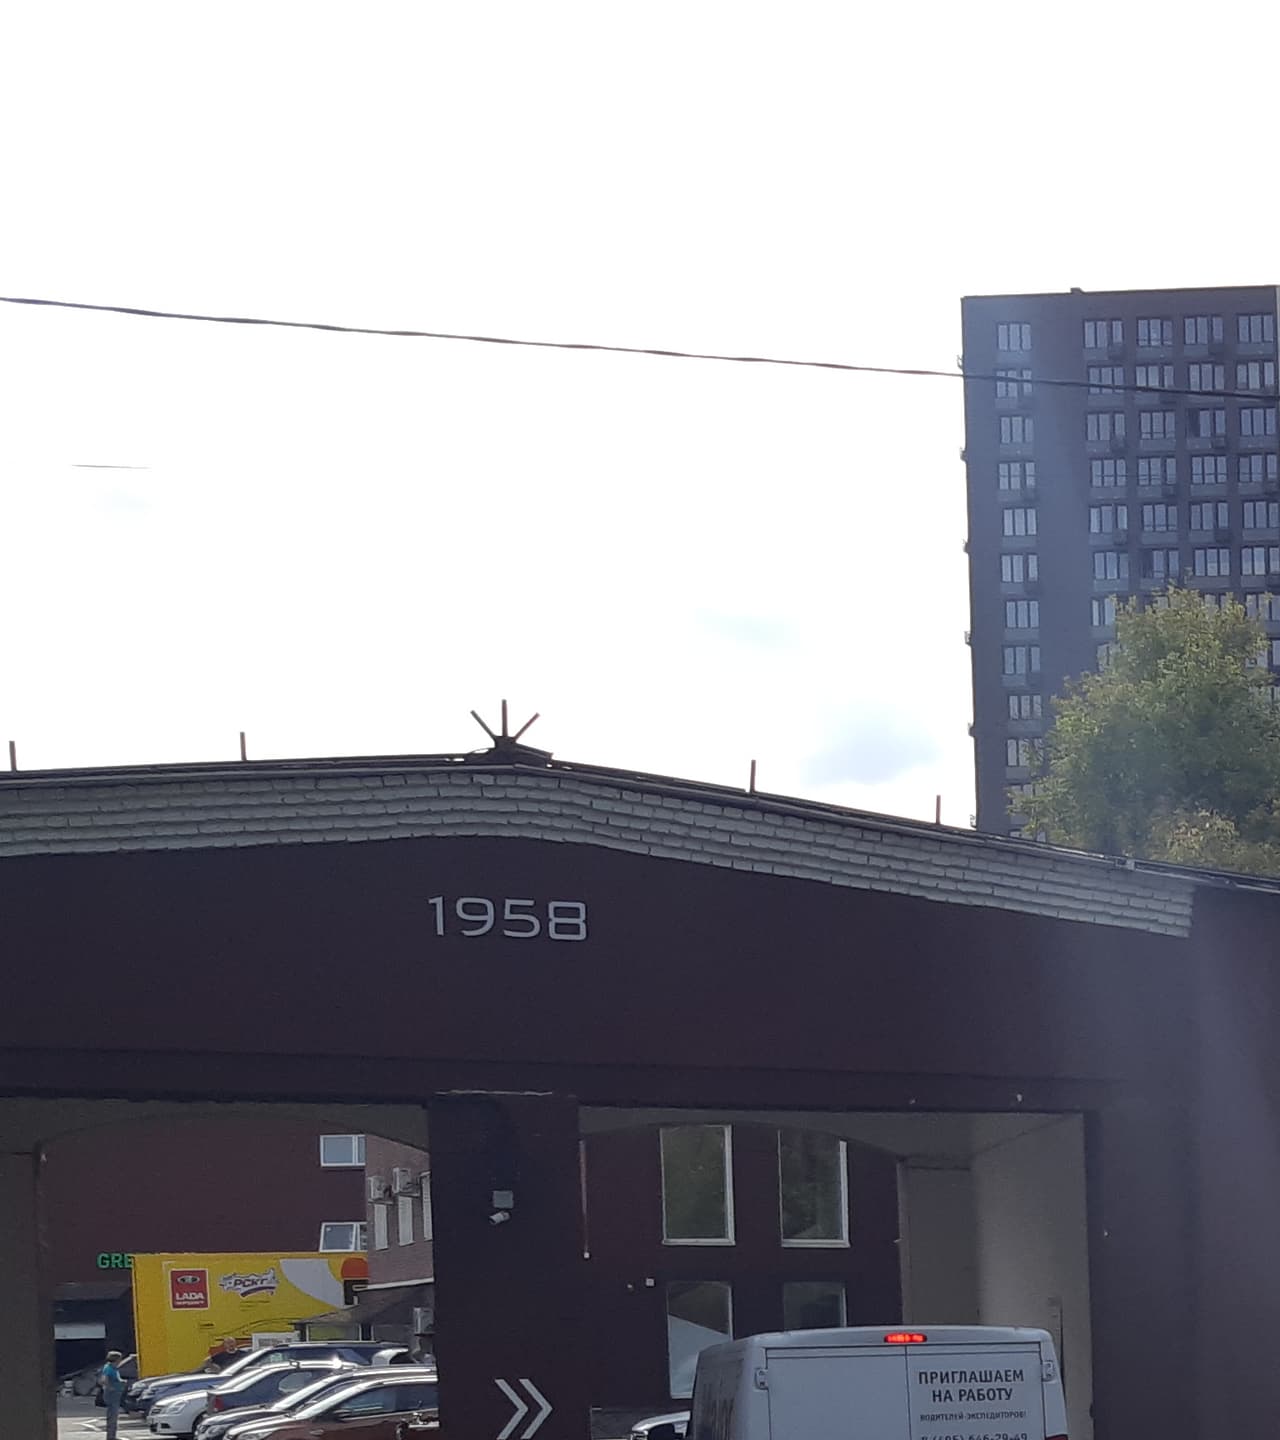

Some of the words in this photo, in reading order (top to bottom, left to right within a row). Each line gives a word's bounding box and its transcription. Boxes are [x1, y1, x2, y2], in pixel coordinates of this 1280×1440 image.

[427, 895, 588, 941] 1958
[175, 1292, 204, 1300] LADA
[918, 1369, 1024, 1384] ПРИГЛАШАЕМ
[932, 1389, 953, 1403] НА
[959, 1387, 1013, 1402] РАБОТУ
